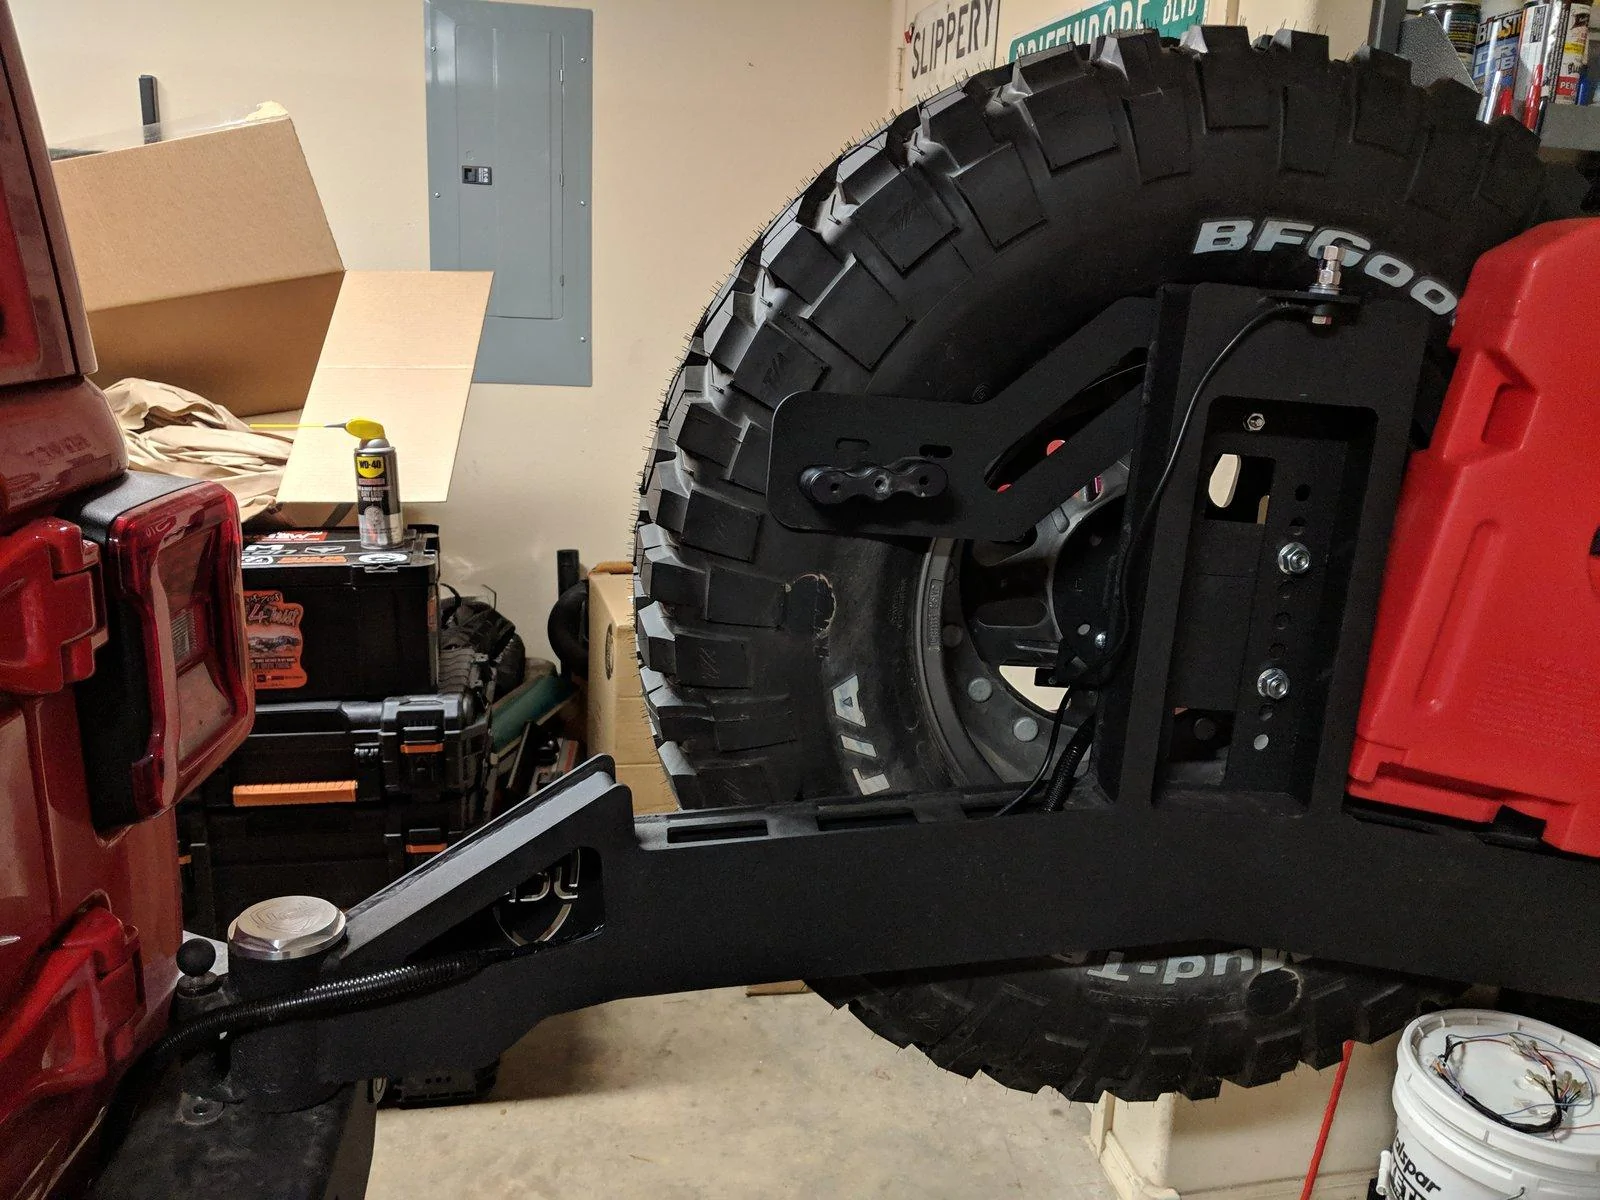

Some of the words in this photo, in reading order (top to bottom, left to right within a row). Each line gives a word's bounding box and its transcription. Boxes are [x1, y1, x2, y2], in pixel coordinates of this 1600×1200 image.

[911, 0, 994, 79] SLIPPERY
[359, 460, 382, 469] WD-40
[1394, 1130, 1442, 1193] alspar
